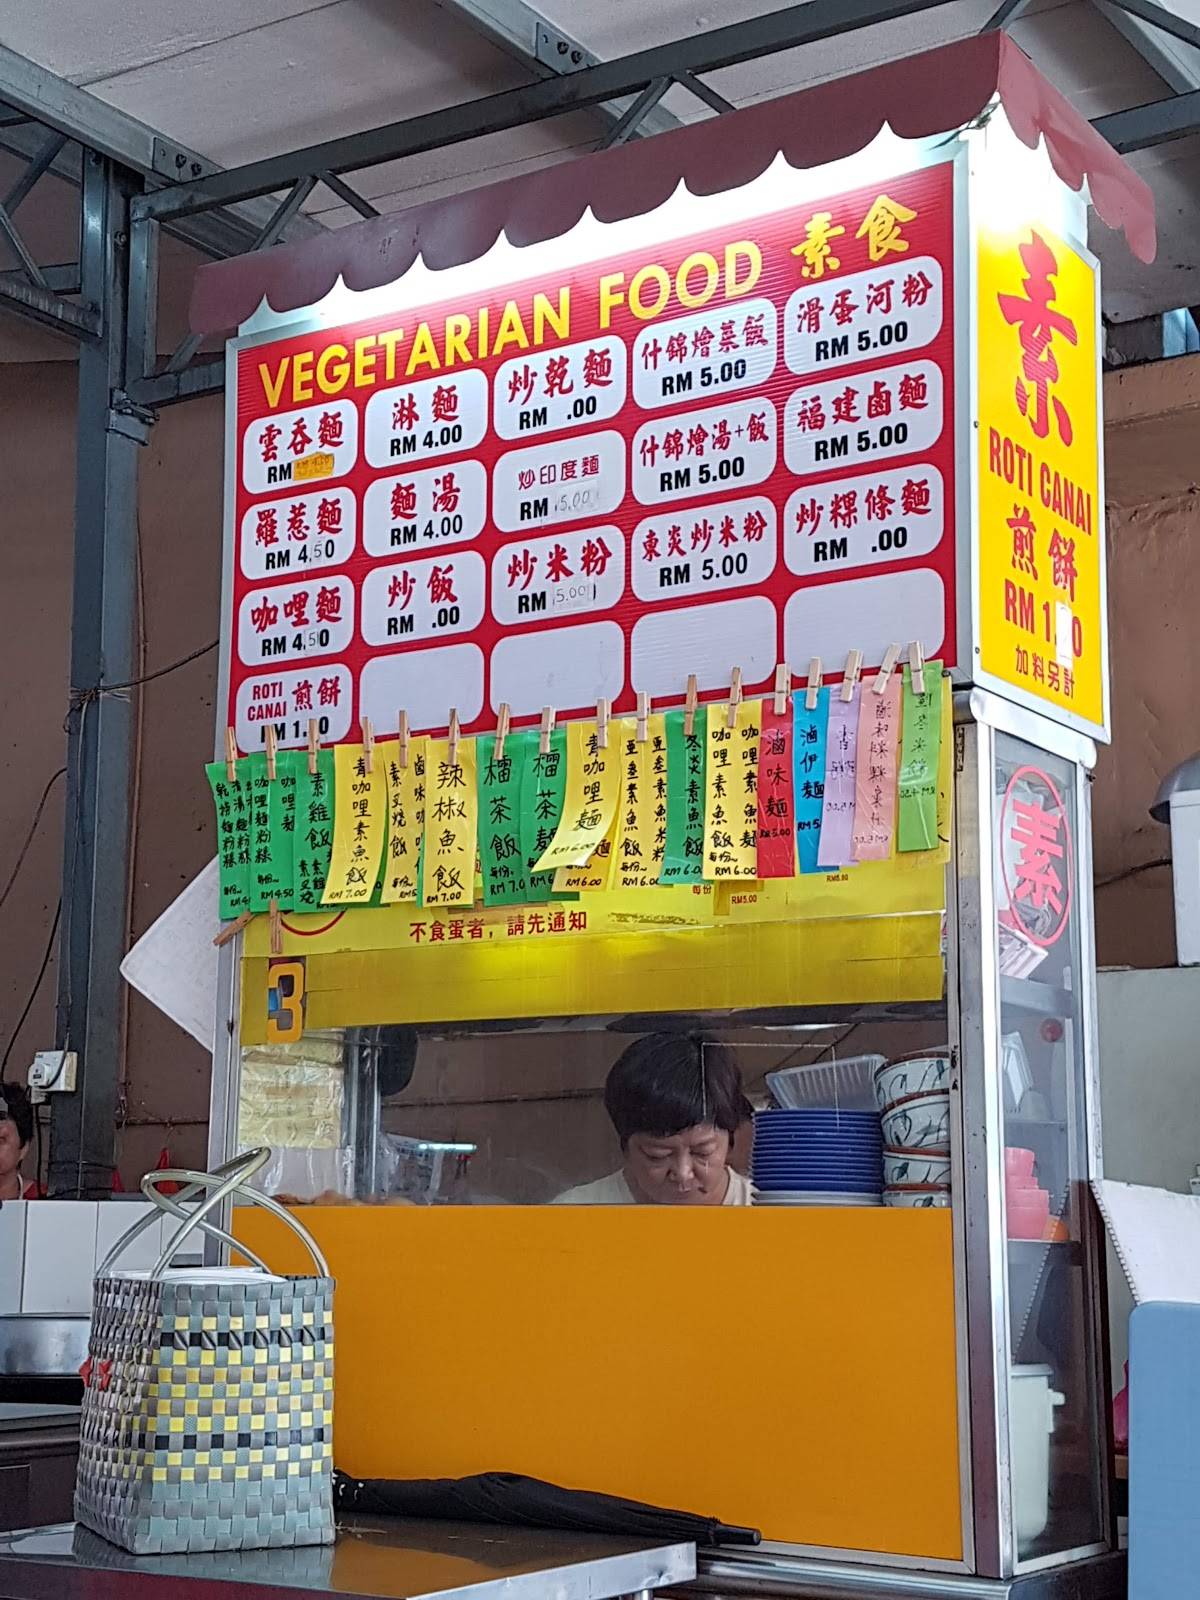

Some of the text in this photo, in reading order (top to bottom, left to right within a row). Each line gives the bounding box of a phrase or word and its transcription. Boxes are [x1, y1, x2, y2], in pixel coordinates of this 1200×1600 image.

[259, 195, 917, 408] VEGETARIAN FOOD 素食
[797, 271, 933, 334] 滑蛋河粉
[816, 321, 908, 362] RM 5.00
[997, 228, 1077, 447] 素
[508, 348, 613, 405] 炒乾麵
[662, 359, 746, 396] RM 5.00
[391, 385, 459, 430] 淋麵
[519, 408, 547, 430] RM
[797, 373, 929, 433] 福建鹵麵
[259, 412, 343, 462] 雲吞麵
[391, 425, 462, 456] RM 4.00
[815, 422, 908, 461] RM 5.00
[267, 463, 292, 484] RM
[519, 455, 599, 490] 炒印度麵
[660, 456, 745, 491] RM 5.00
[989, 426, 1092, 536] ROTI CANAI
[390, 473, 460, 520] 麵湯
[520, 498, 548, 521] RM
[255, 498, 343, 547] 羅惹麵
[391, 515, 463, 546] RM 4.00
[642, 509, 768, 562] 東炎炒米粉
[266, 539, 334, 570] RM 4.50
[508, 537, 612, 591] 炒米粉
[814, 537, 847, 562] RM
[1006, 503, 1078, 602] 煎餅
[387, 564, 458, 610] 炒飯
[659, 552, 748, 587] RM 5.00
[251, 586, 342, 633] 咖哩麵
[518, 591, 546, 614] RM
[1005, 578, 1035, 635] RM
[262, 629, 329, 656] RM 4.50
[387, 614, 414, 635] RM
[1016, 644, 1075, 699] 加料另計
[253, 681, 282, 700] ROTI
[292, 676, 341, 711] 煎餅
[247, 701, 287, 721] CANAI
[293, 716, 329, 738] 1.0
[432, 761, 467, 892] 辣椒魚飯
[715, 866, 757, 876] RM 6.00
[1011, 800, 1063, 915] 素
[441, 892, 461, 901] 7.00
[490, 883, 507, 895] RM
[530, 876, 546, 887] RM
[622, 878, 638, 886] RM
